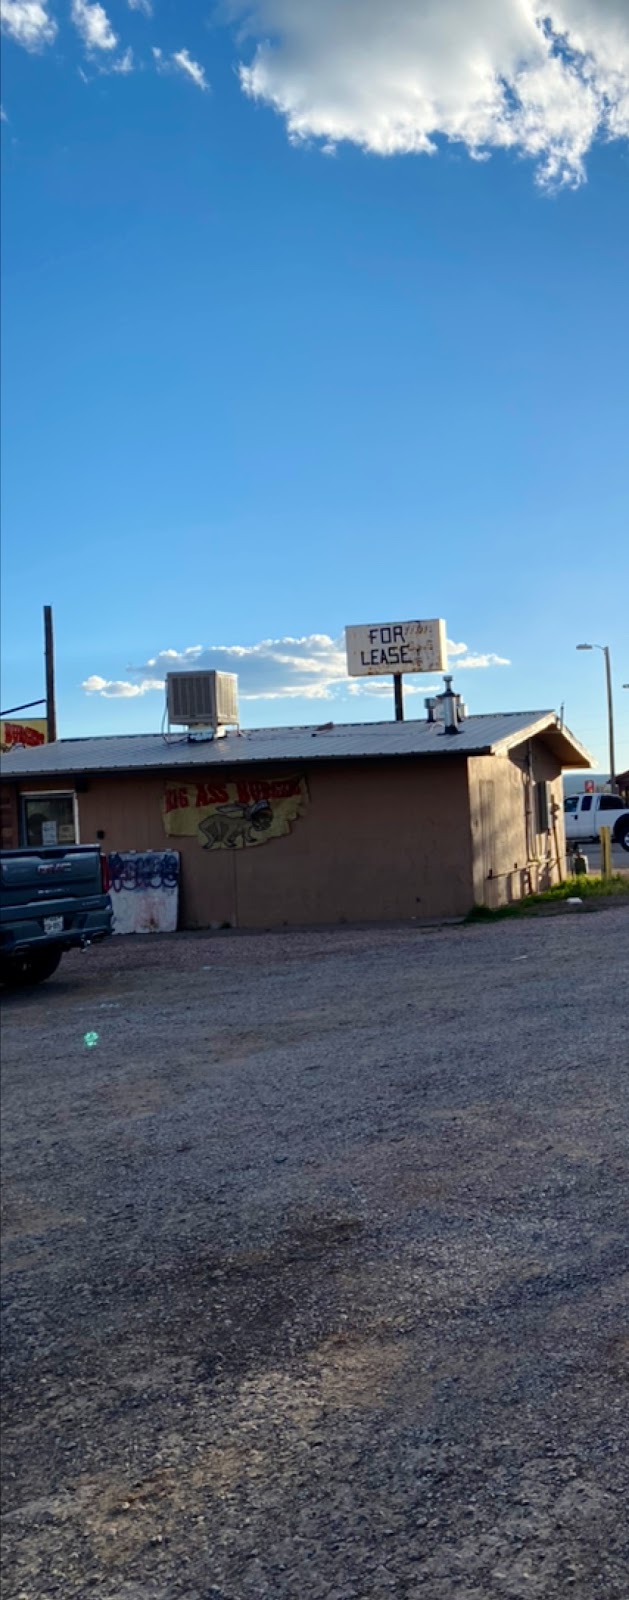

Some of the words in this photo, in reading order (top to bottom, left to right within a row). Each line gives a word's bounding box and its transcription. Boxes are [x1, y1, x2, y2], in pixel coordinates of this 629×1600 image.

[369, 626, 405, 644] FOR
[361, 644, 413, 665] LEASE
[164, 787, 190, 812] BIG
[195, 783, 230, 807] ASS
